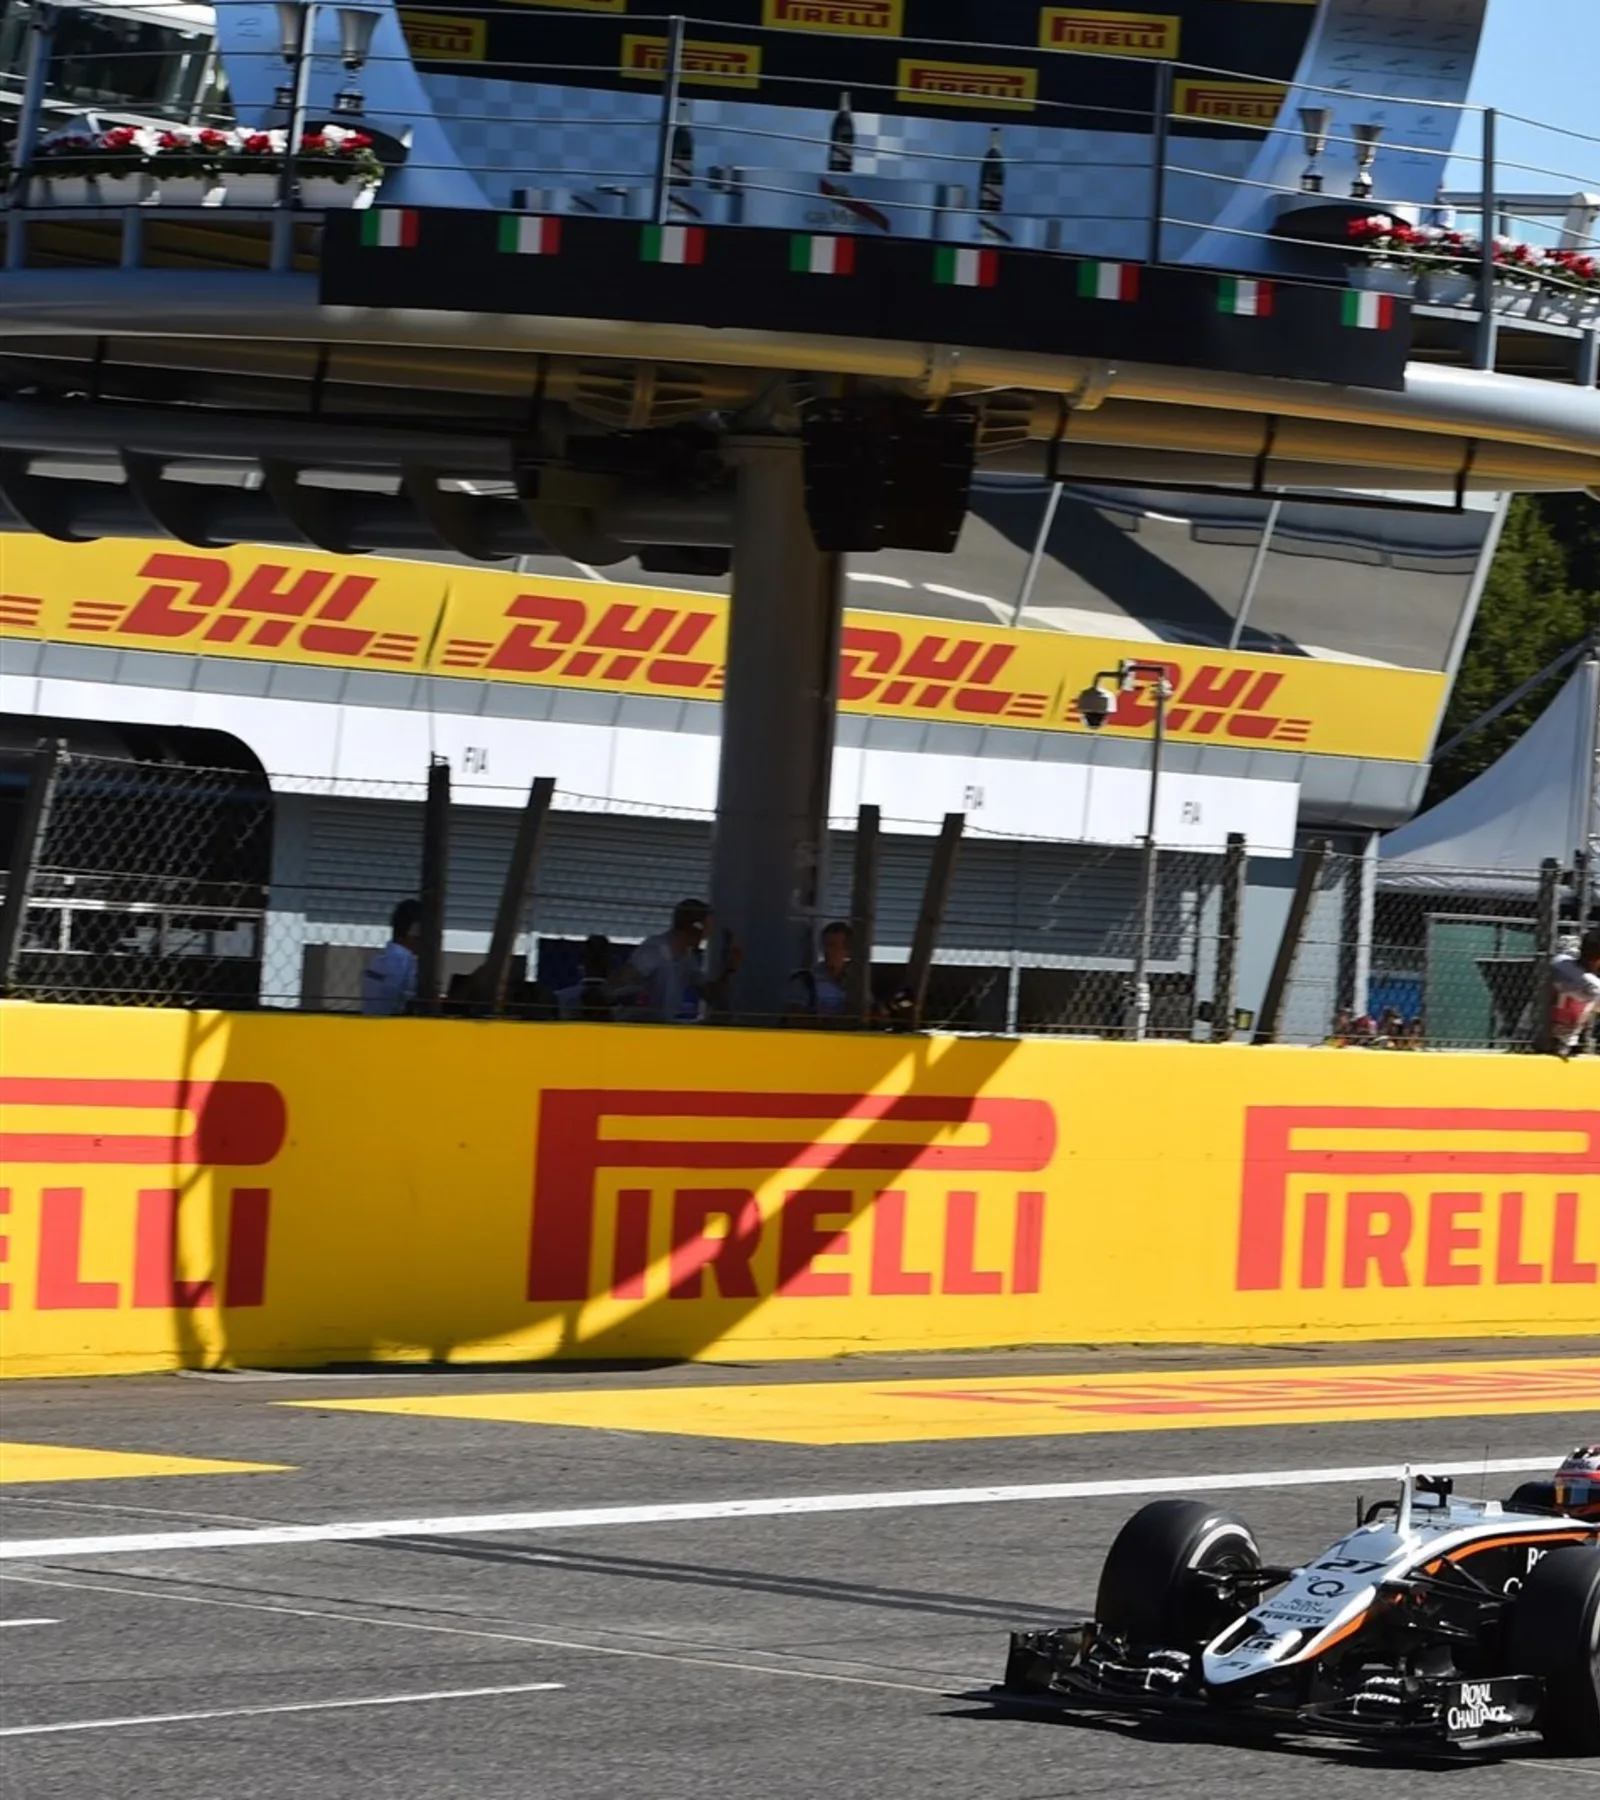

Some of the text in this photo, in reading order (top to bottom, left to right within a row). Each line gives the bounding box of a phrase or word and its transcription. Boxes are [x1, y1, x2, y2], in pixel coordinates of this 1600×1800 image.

[774, 0, 891, 28] PIRELLI
[1052, 16, 1167, 49] PIRELLI
[910, 68, 1024, 99] PIRELLI
[118, 553, 378, 655] DHL
[484, 593, 717, 688] DHL
[837, 626, 1017, 714] DHL
[1107, 657, 1285, 739] DHL
[527, 1088, 1058, 1302] PIRELLI
[1316, 1558, 1388, 1574] 27
[1256, 1610, 1326, 1625] PIRELLI
[1461, 1684, 1492, 1708] ROYAL
